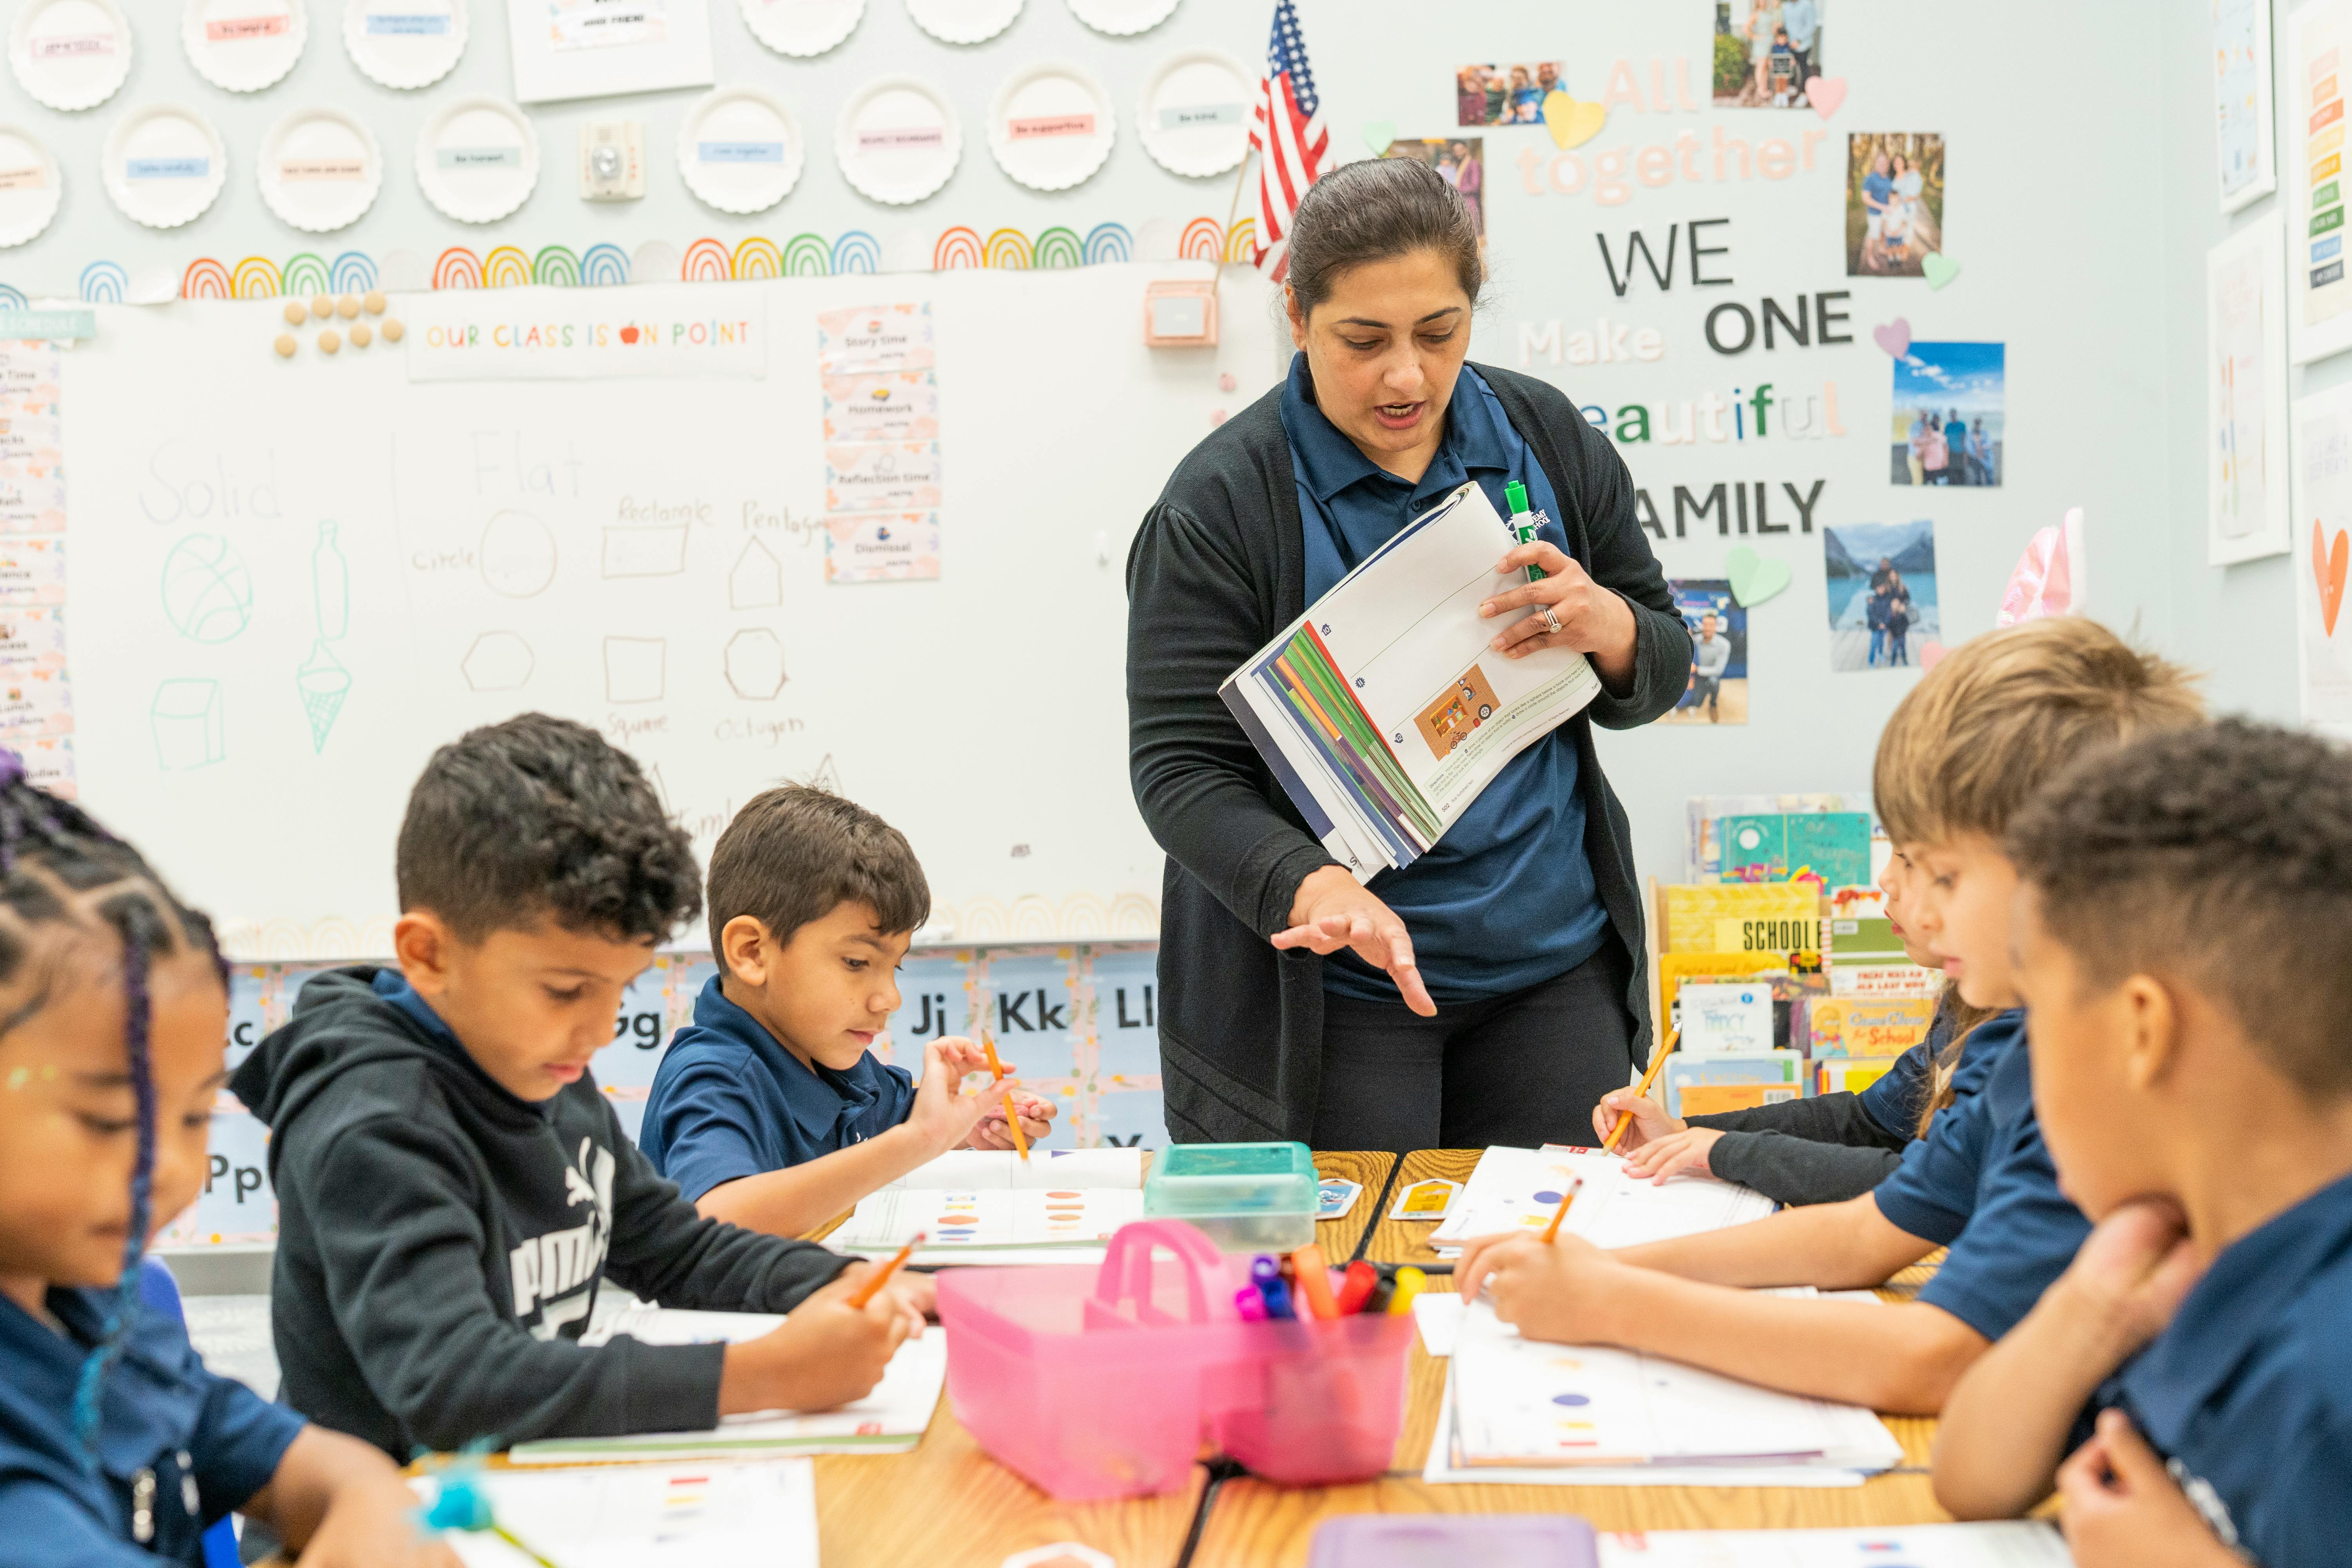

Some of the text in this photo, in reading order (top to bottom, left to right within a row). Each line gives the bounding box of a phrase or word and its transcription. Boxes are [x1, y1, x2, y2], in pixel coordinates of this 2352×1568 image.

[1603, 57, 1697, 114] All
[1517, 126, 1826, 207] together
[1595, 218, 1734, 298] WE
[427, 325, 480, 348] OUR
[493, 325, 575, 348] CLASS
[588, 323, 608, 347] IS
[672, 319, 748, 347] POINT
[845, 336, 877, 348] Story
[1518, 316, 1665, 367] Make
[1704, 290, 1854, 355] ONE
[848, 404, 913, 414] Homework
[1580, 381, 1846, 445] eautiful
[138, 429, 584, 527] Solid Flat
[838, 474, 901, 485] Reflection
[743, 500, 827, 549] Pentago
[1636, 479, 1827, 540] AMILY
[411, 545, 475, 572] Circle
[1322, 626, 1330, 635] 10
[1429, 773, 1444, 788] Directions
[1478, 732, 1488, 742] picture
[1495, 717, 1504, 726] object
[1530, 693, 1542, 702] sphere
[1541, 687, 1553, 695] below
[1433, 783, 1441, 792] object
[1485, 732, 1494, 741] object
[1537, 694, 1550, 703] around
[1556, 683, 1568, 692] objects
[1442, 803, 1450, 812] 502
[1456, 784, 1469, 797] hundred
[1444, 778, 1454, 788] objects
[1743, 920, 1810, 951] SCHOOL
[911, 994, 947, 1039] Jj
[998, 989, 1069, 1033] Kk
[1869, 1026, 1916, 1046] School
[204, 1154, 262, 1203] Pp
